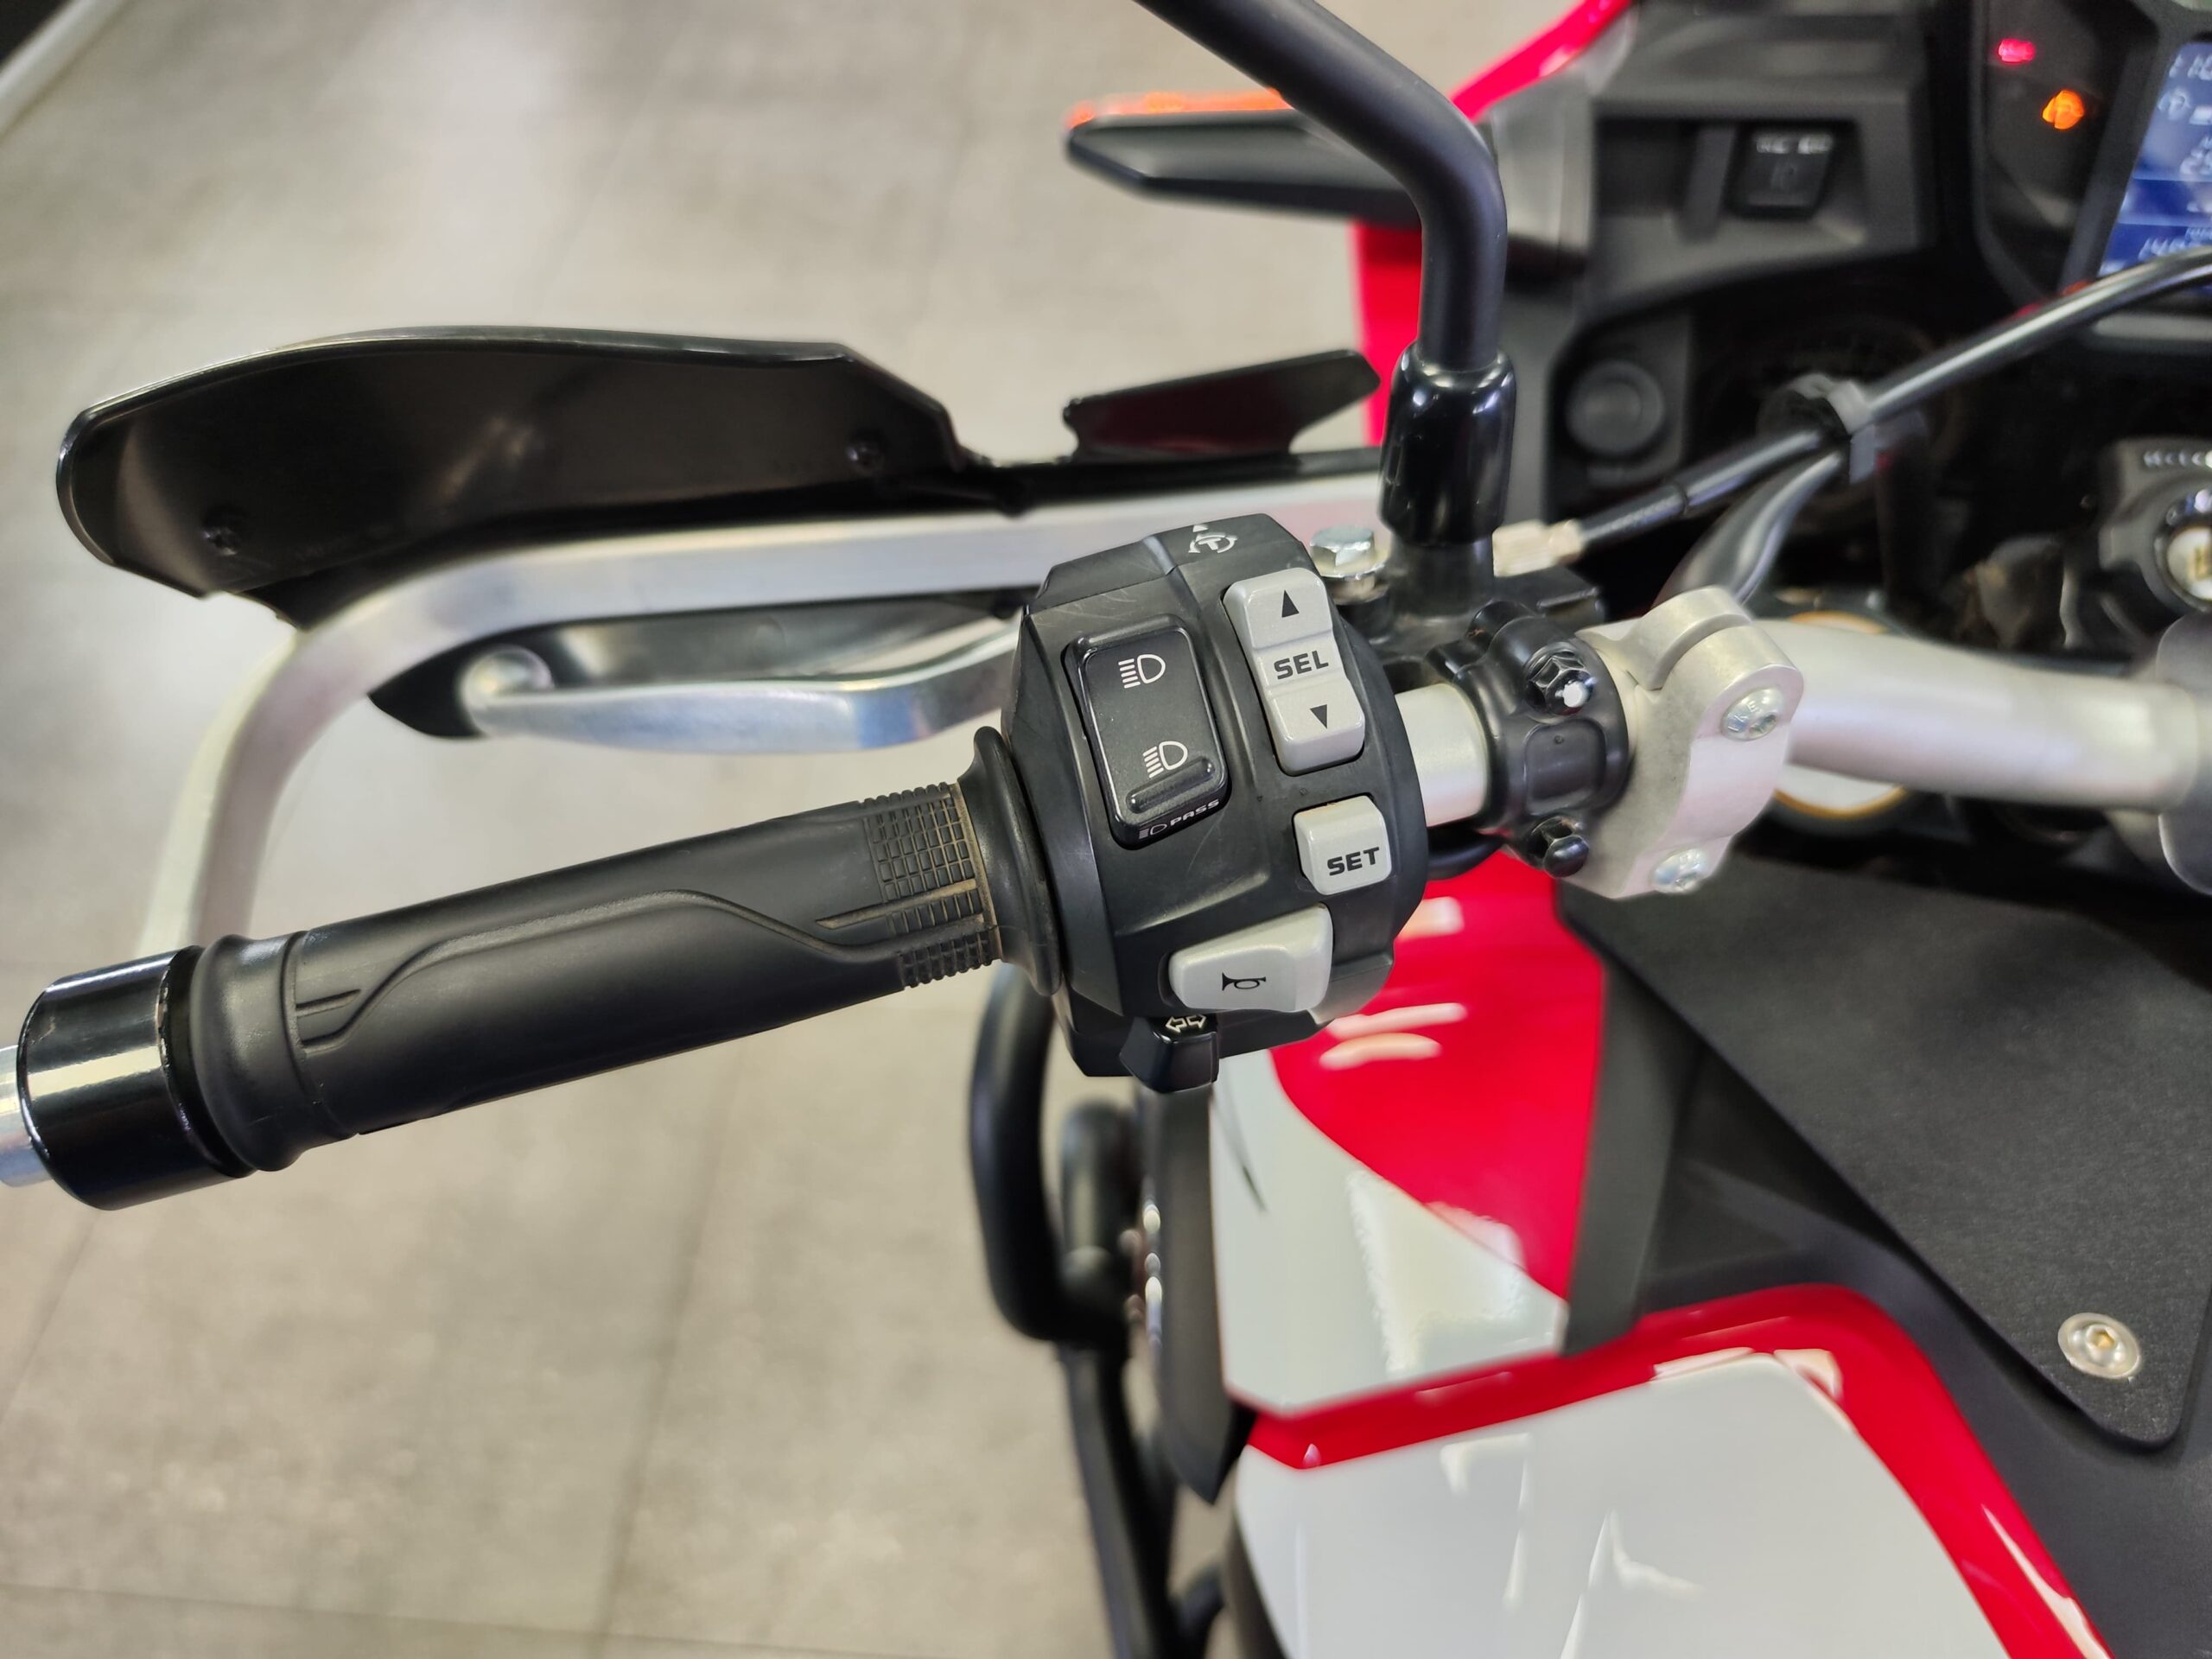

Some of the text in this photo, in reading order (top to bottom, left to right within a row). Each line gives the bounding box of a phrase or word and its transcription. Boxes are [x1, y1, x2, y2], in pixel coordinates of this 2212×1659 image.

[1274, 650, 1329, 680] SEL
[1170, 798, 1219, 826] PASS
[1327, 846, 1380, 876] SET
